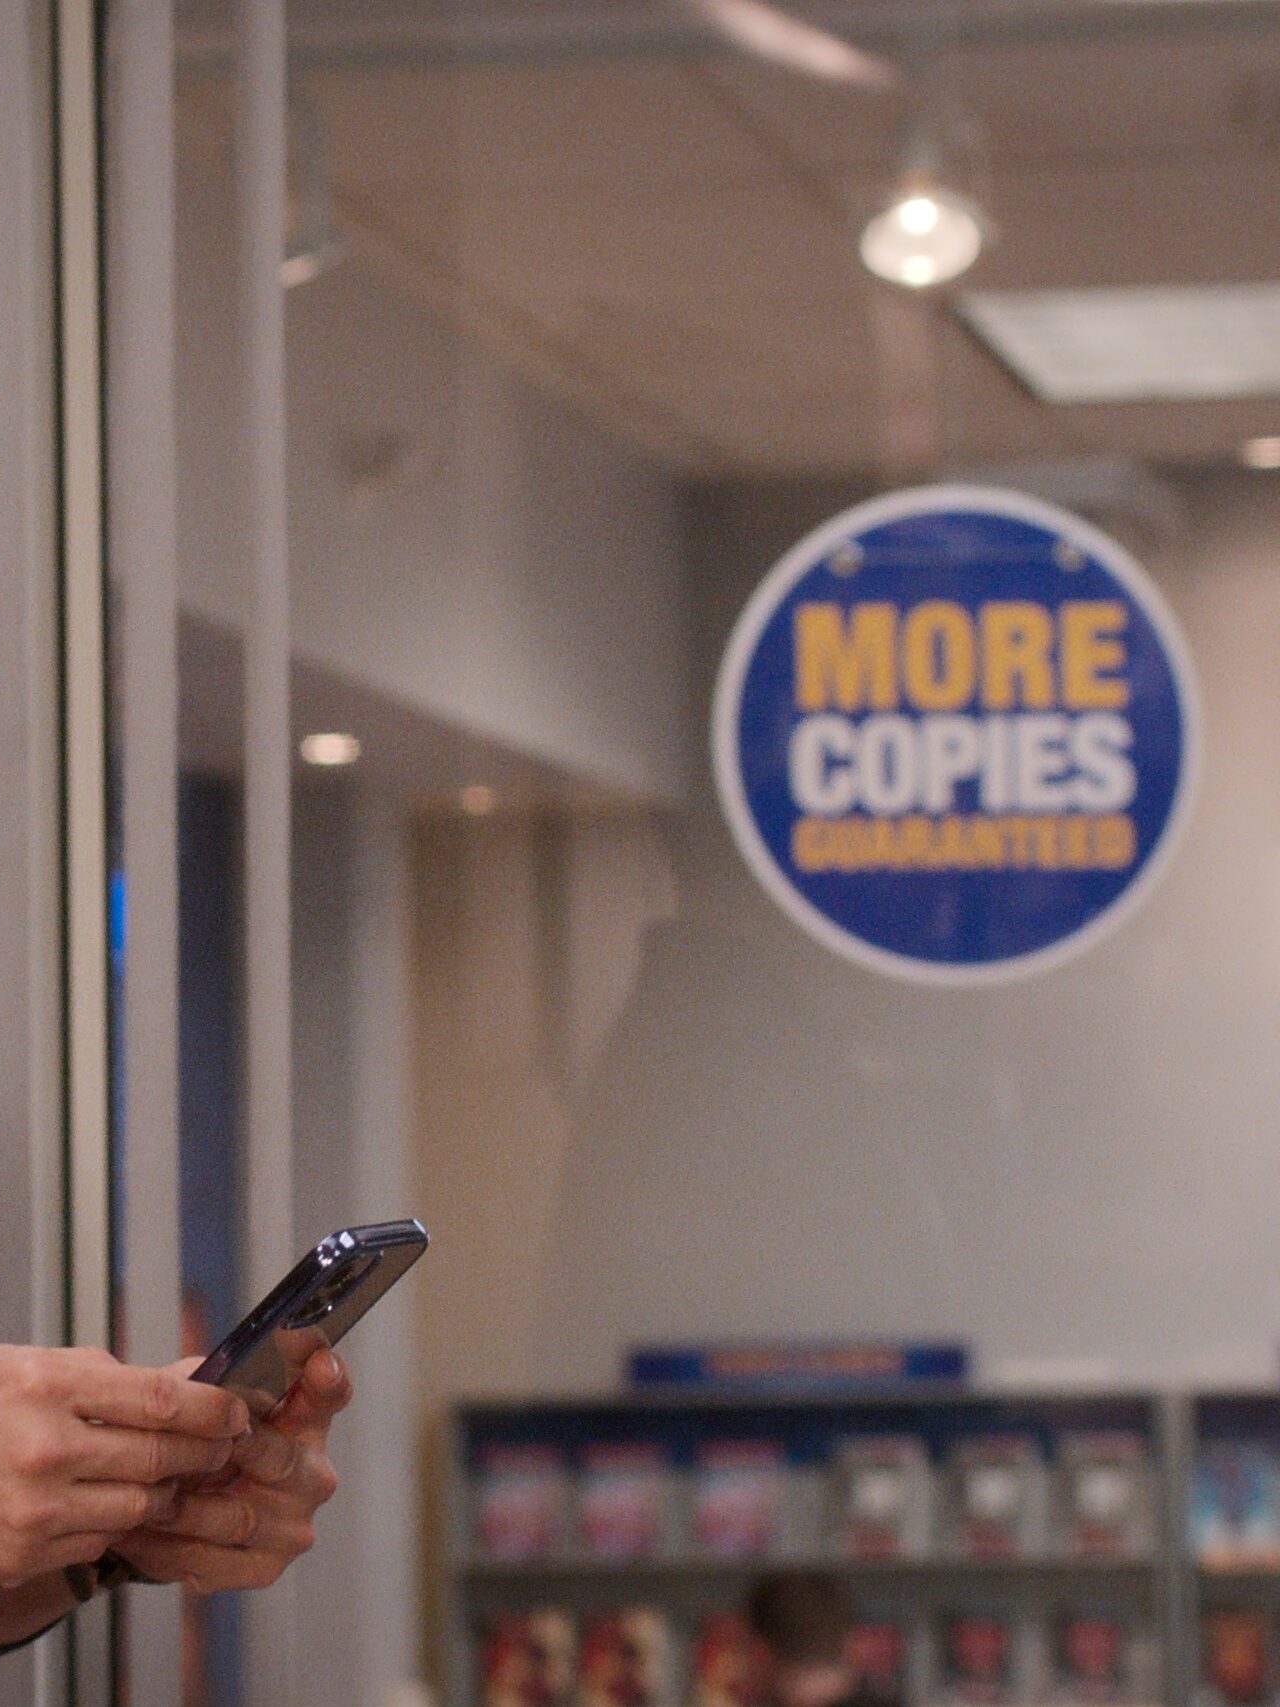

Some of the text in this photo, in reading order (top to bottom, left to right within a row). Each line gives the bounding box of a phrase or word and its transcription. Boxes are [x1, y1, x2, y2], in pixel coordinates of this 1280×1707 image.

[793, 602, 1130, 711] MORE
[788, 713, 1136, 815] COPIES
[792, 816, 1136, 872] GUARANTEED
